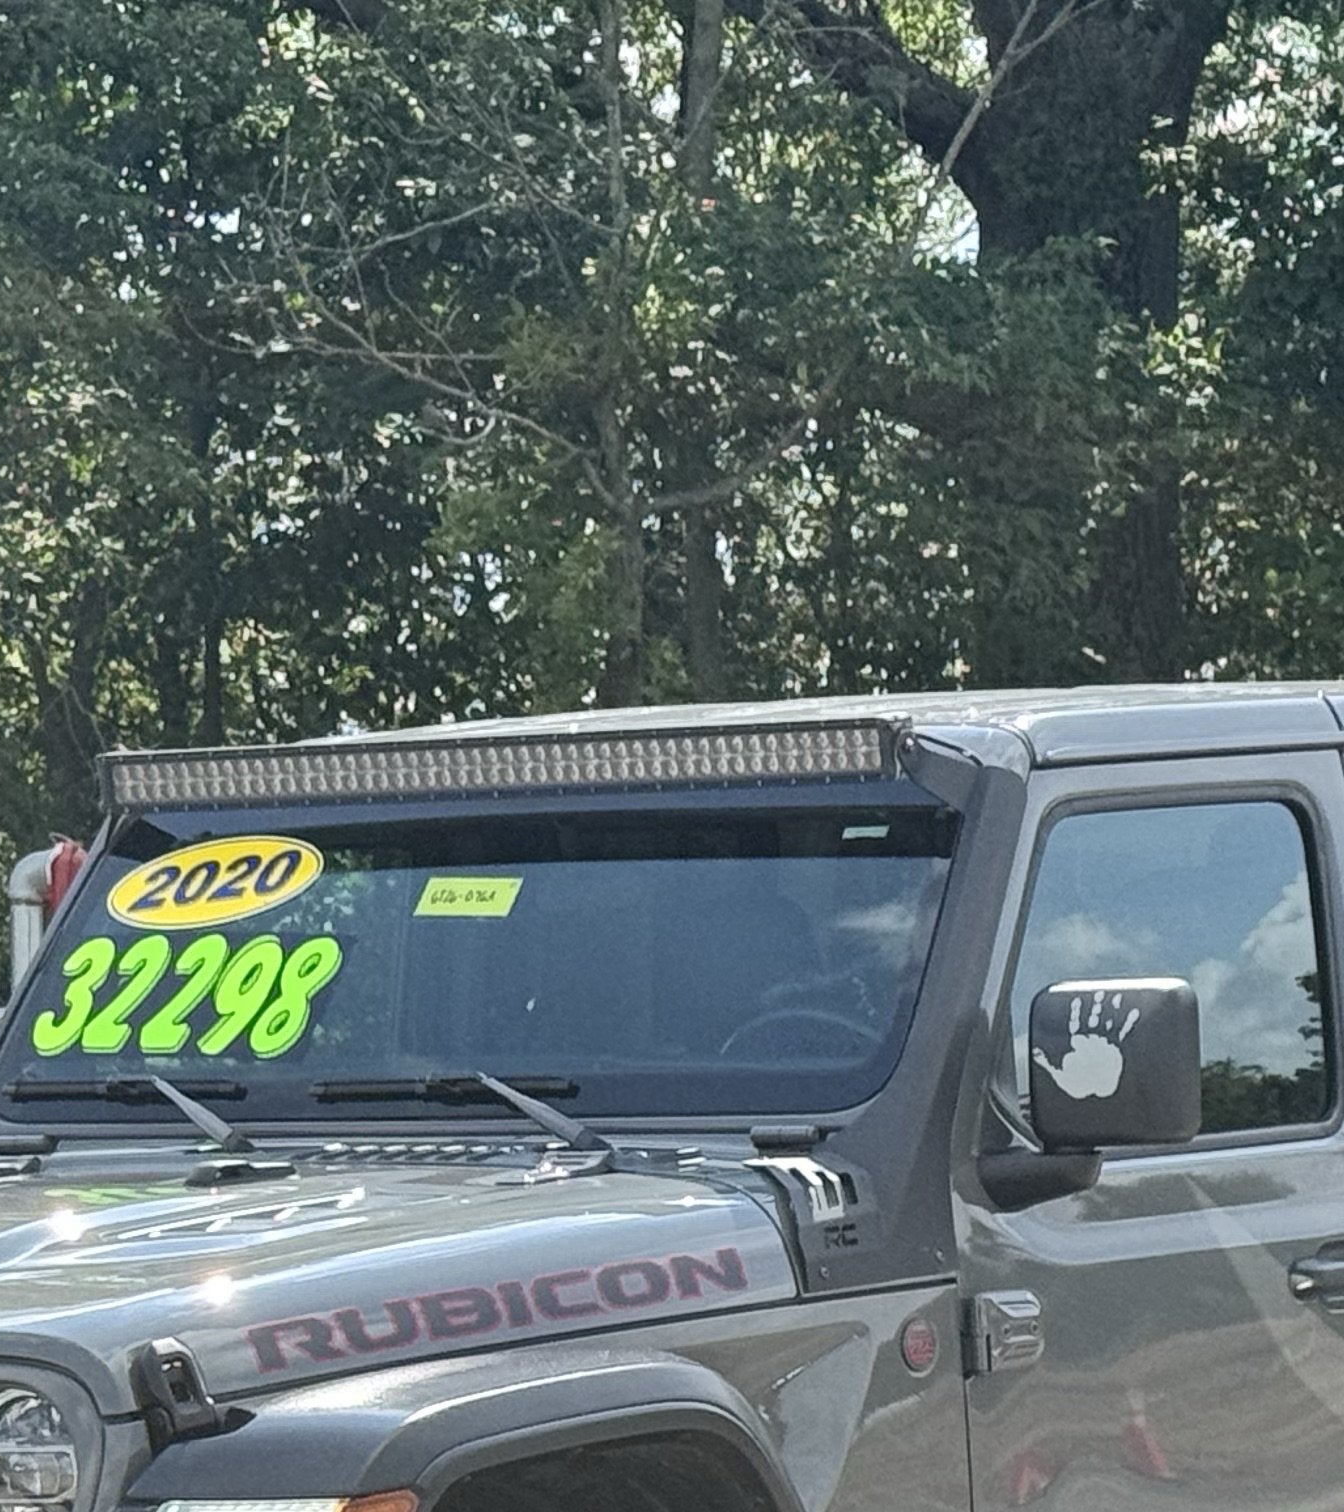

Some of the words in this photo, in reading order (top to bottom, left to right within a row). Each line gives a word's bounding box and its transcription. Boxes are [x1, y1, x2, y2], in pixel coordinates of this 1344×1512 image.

[128, 848, 303, 914] 2020
[32, 933, 343, 1060] 32298
[245, 1247, 749, 1374] RUBICON
